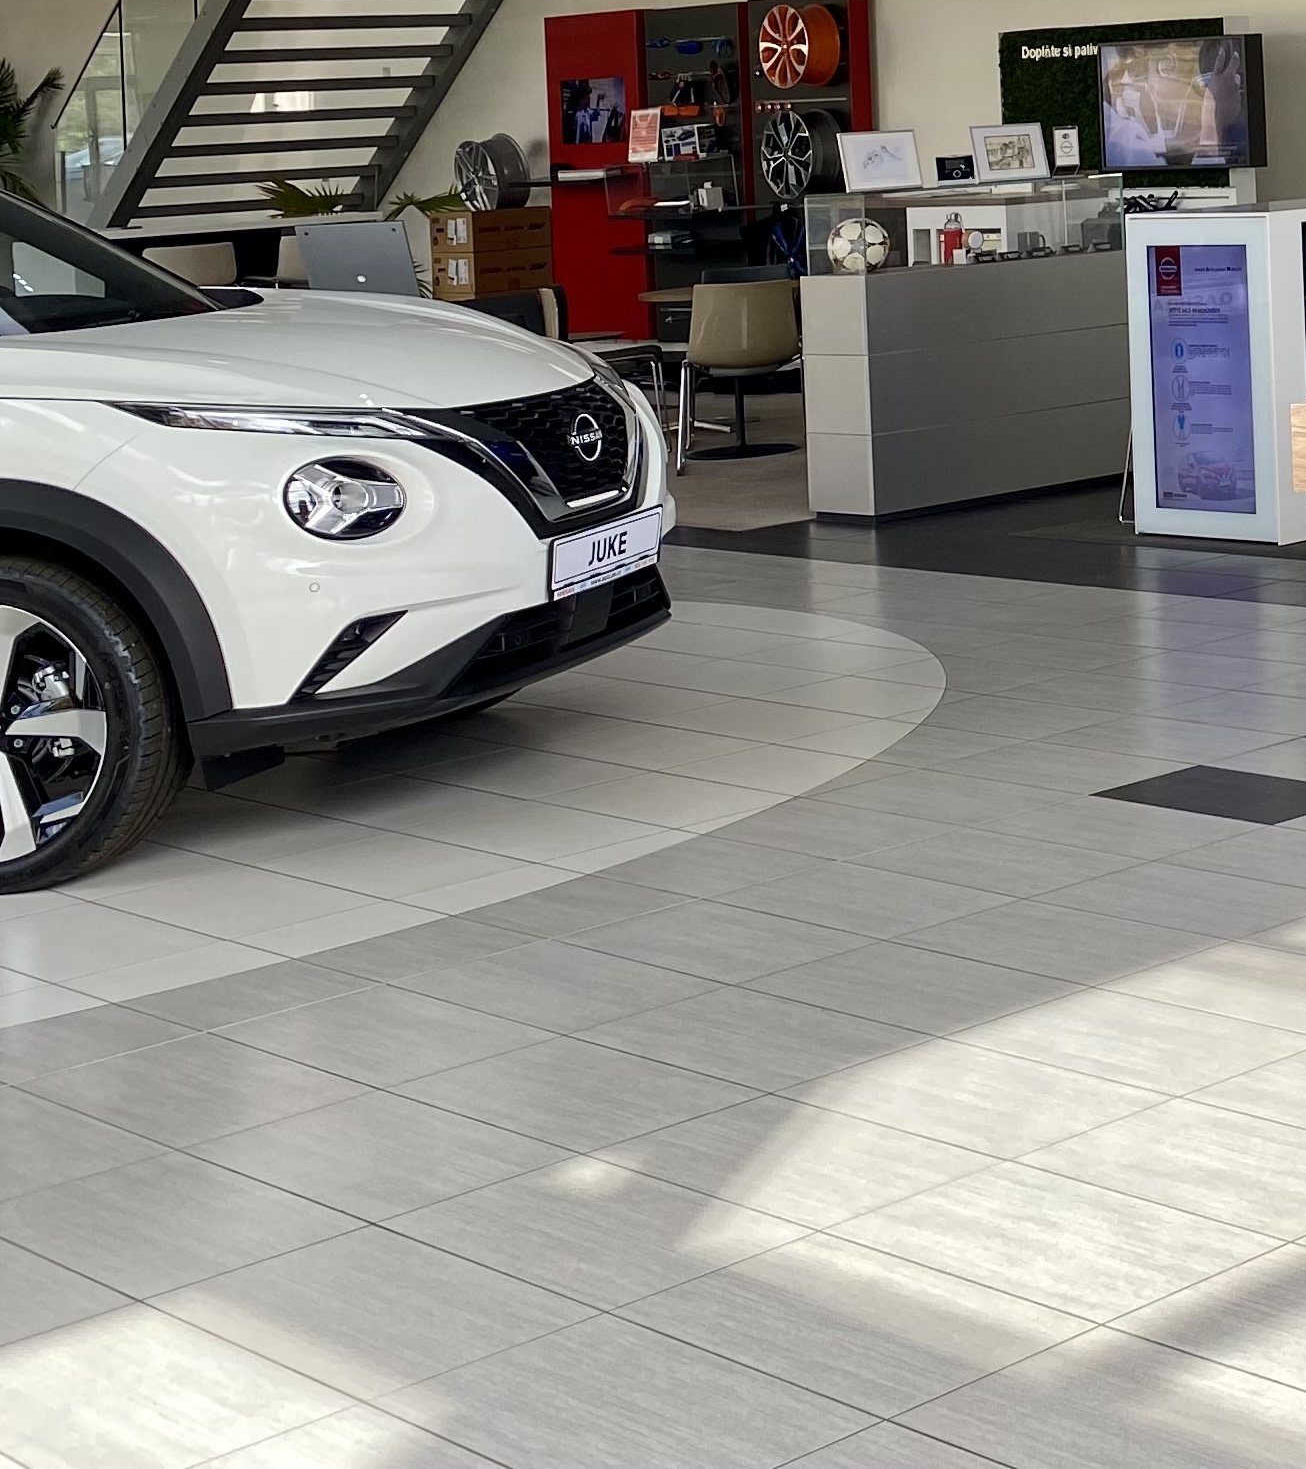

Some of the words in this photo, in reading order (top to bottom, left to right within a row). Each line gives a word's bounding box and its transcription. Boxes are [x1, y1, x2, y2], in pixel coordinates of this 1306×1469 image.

[1062, 43, 1073, 58] si
[1074, 42, 1099, 60] paliv
[588, 531, 628, 567] JUKE
